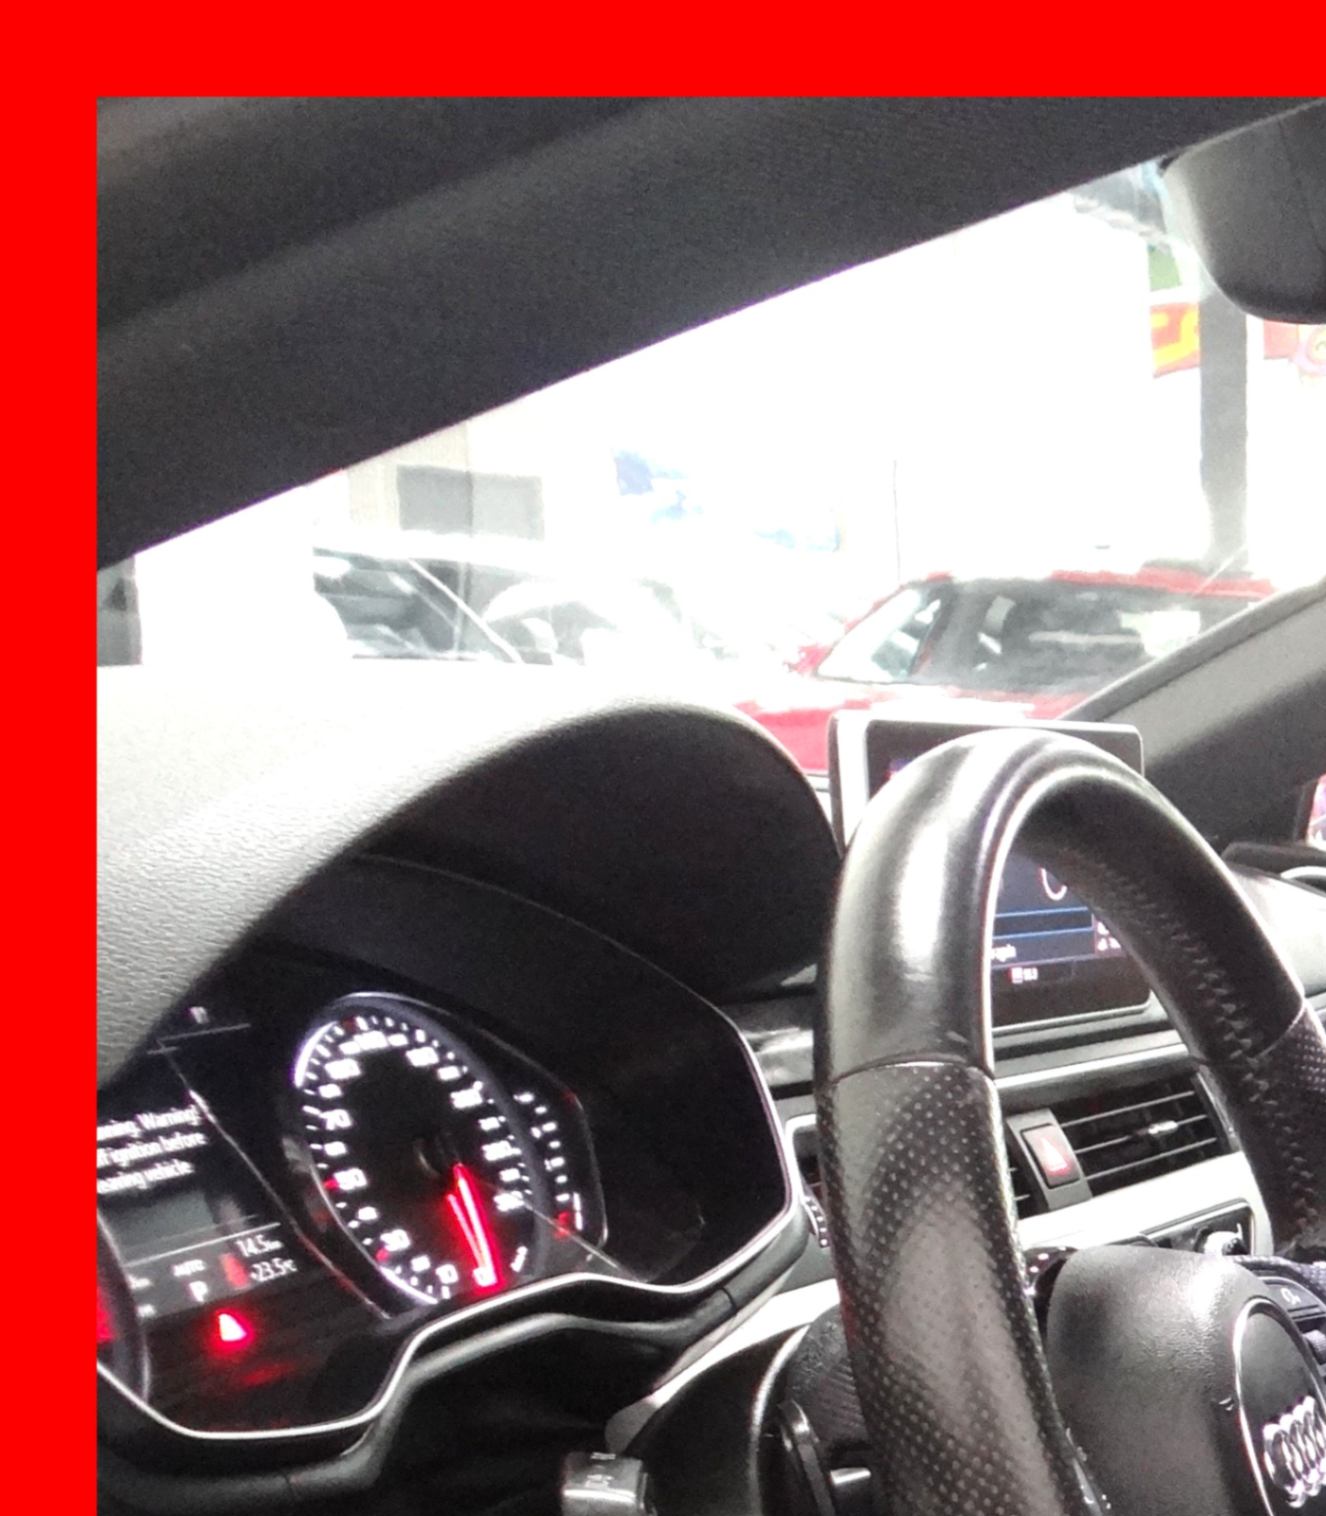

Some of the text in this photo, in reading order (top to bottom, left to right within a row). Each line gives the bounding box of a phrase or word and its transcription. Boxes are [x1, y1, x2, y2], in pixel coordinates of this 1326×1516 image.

[137, 1105, 201, 1130] Warning!
[108, 1142, 164, 1167] ignition
[159, 1132, 207, 1152] before
